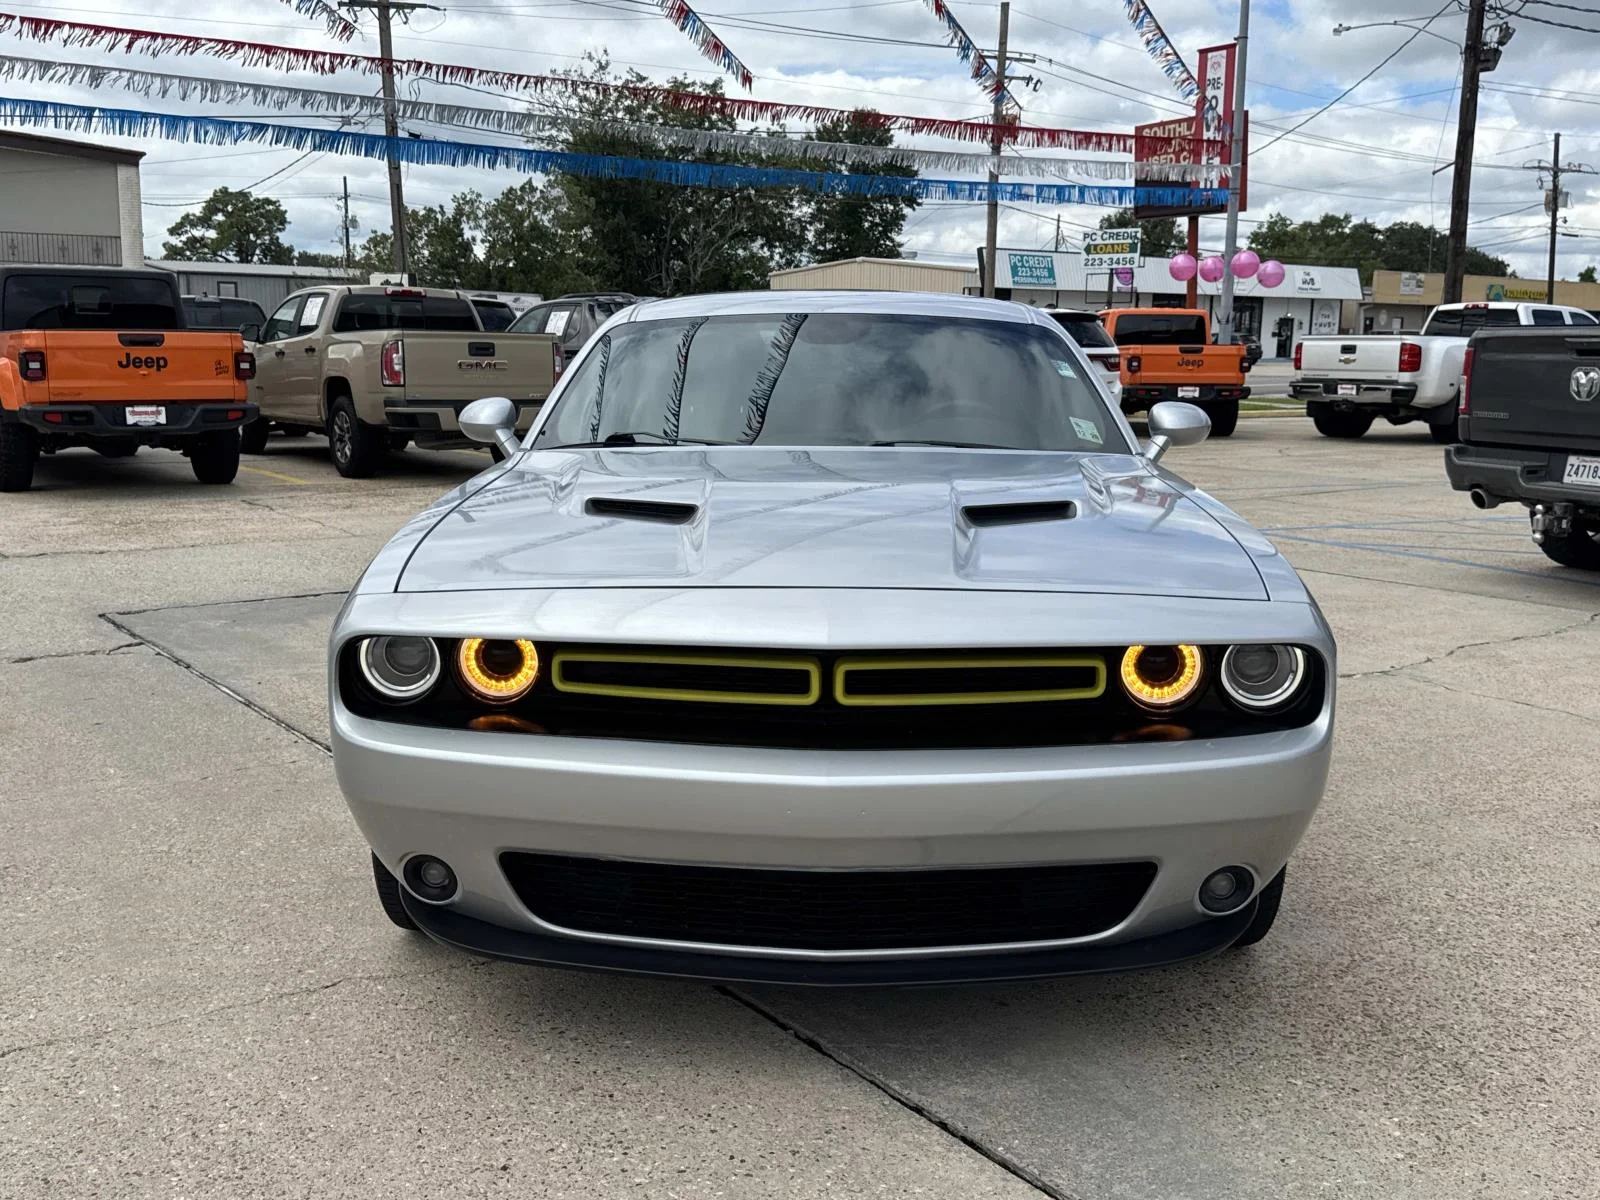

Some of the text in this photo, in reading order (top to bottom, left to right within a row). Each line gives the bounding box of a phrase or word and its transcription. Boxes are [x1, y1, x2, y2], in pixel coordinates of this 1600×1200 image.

[1083, 230, 1140, 242] PC CREDIT
[1090, 243, 1130, 255] LOANS
[1010, 255, 1052, 268] PC CREDIT
[1083, 257, 1135, 267] 223-3456
[117, 352, 169, 372] Jeep
[457, 359, 509, 370] GMC
[1177, 357, 1204, 368] Jeep
